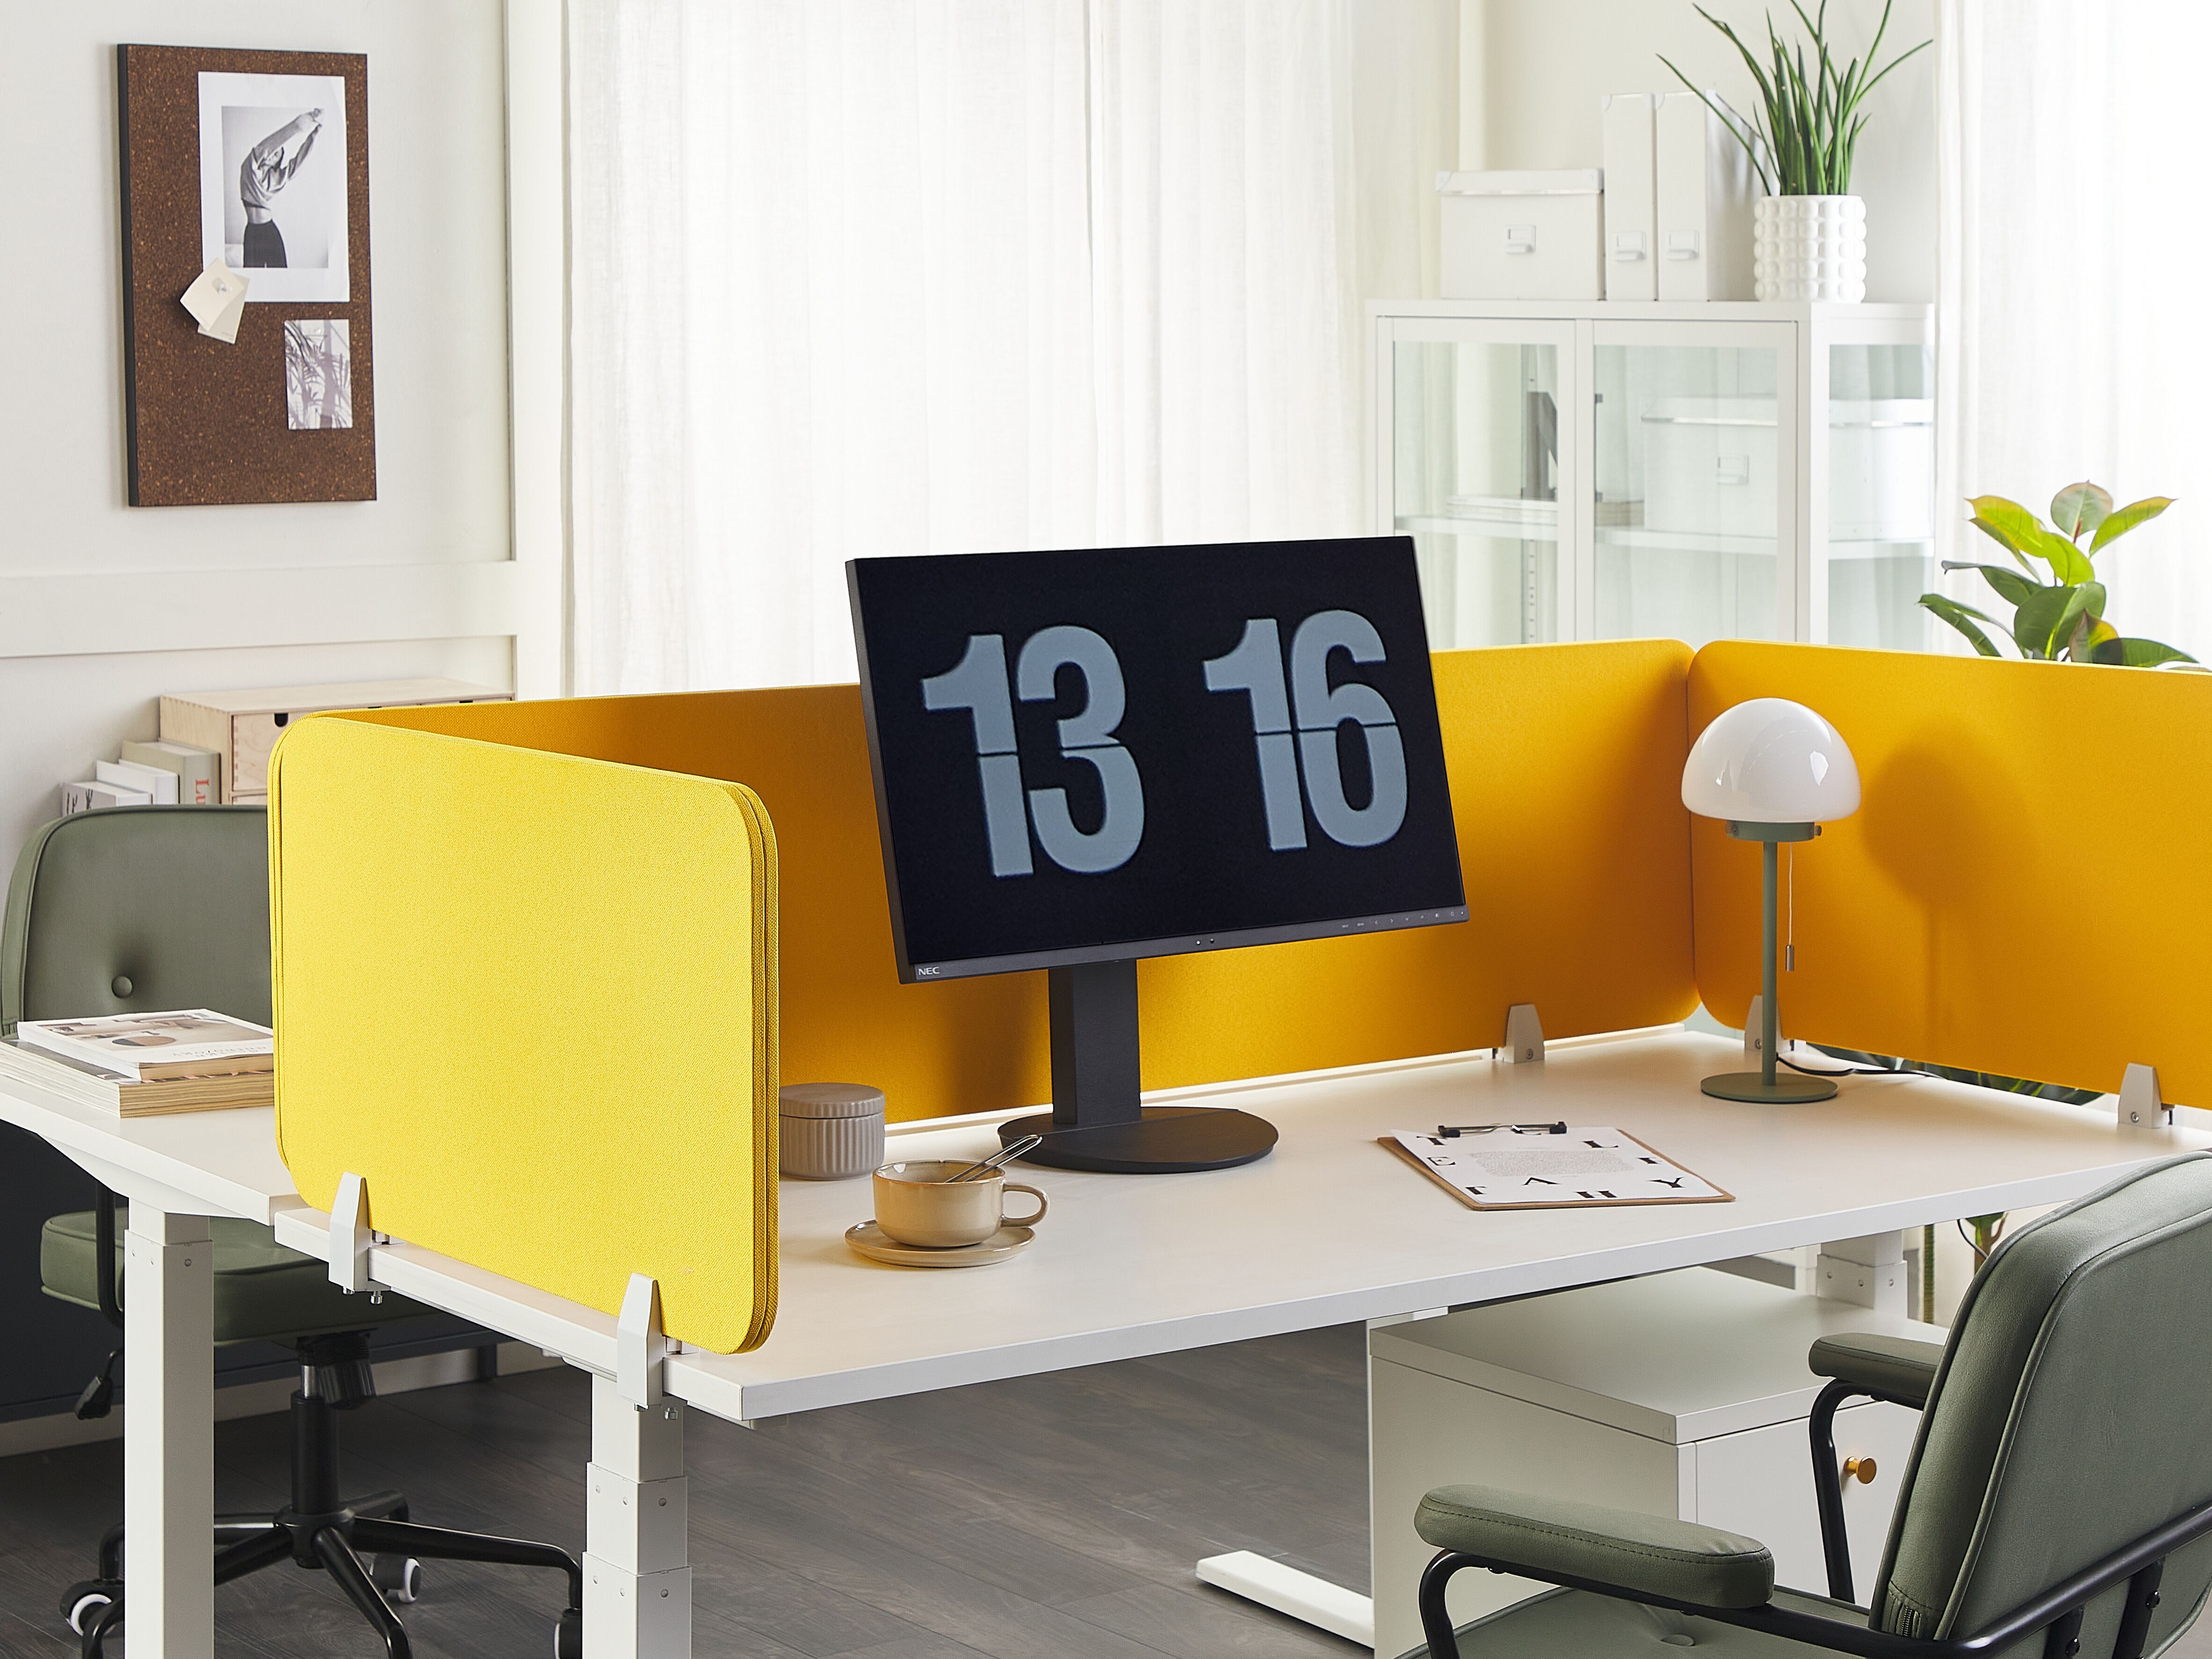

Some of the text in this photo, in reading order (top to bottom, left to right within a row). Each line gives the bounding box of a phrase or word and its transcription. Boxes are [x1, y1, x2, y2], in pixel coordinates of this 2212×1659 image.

[922, 609, 1407, 877] 13 16
[918, 966, 940, 975] NEC
